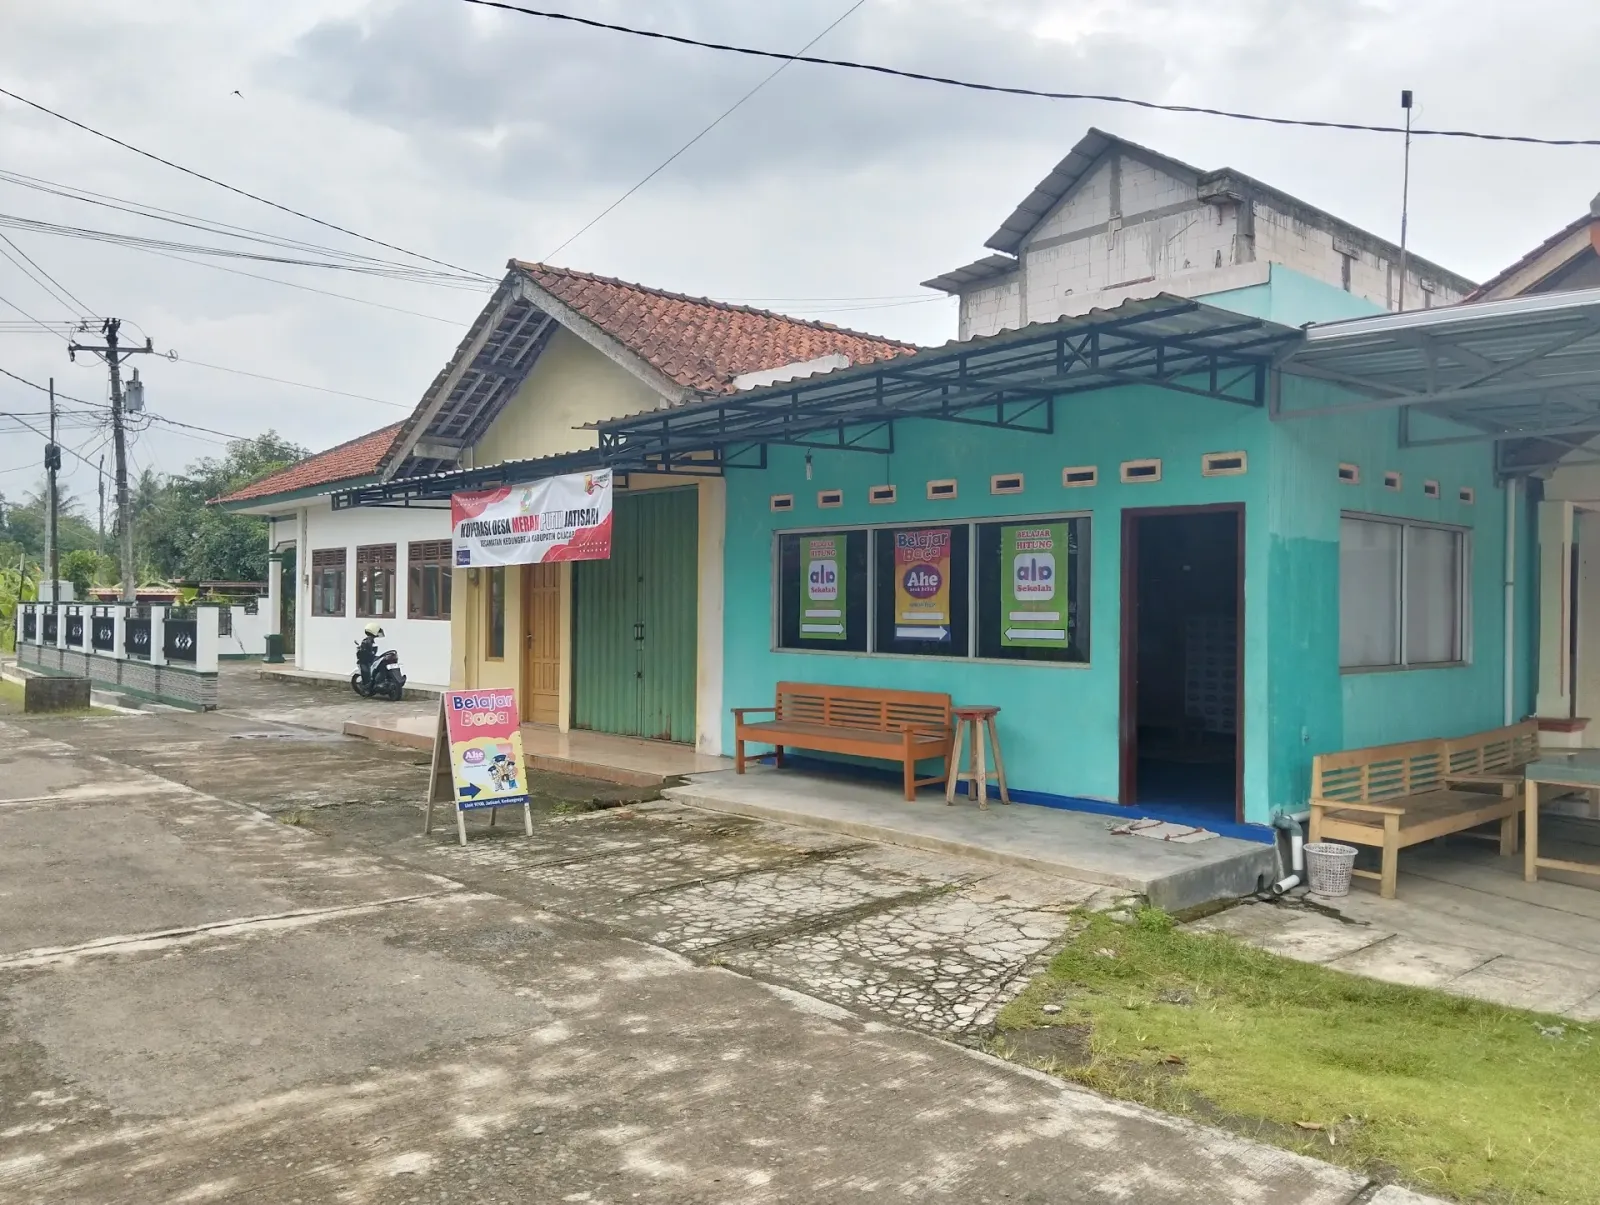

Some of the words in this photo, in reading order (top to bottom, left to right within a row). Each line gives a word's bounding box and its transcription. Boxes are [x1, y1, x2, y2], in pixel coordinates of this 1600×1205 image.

[460, 520, 491, 538] KOPERASI
[492, 518, 511, 536] DESA
[512, 514, 540, 534] MERAH
[540, 510, 563, 531] PUTIH
[564, 507, 599, 528] JATISARI
[897, 532, 948, 549] Belajar
[1016, 530, 1051, 538] BELAJAR
[1016, 540, 1053, 550] HITUNG
[810, 550, 836, 558] HITUNG
[903, 547, 941, 562] Baca
[907, 571, 938, 587] Ahe
[452, 694, 512, 711] Belajar
[461, 710, 509, 726] Baca
